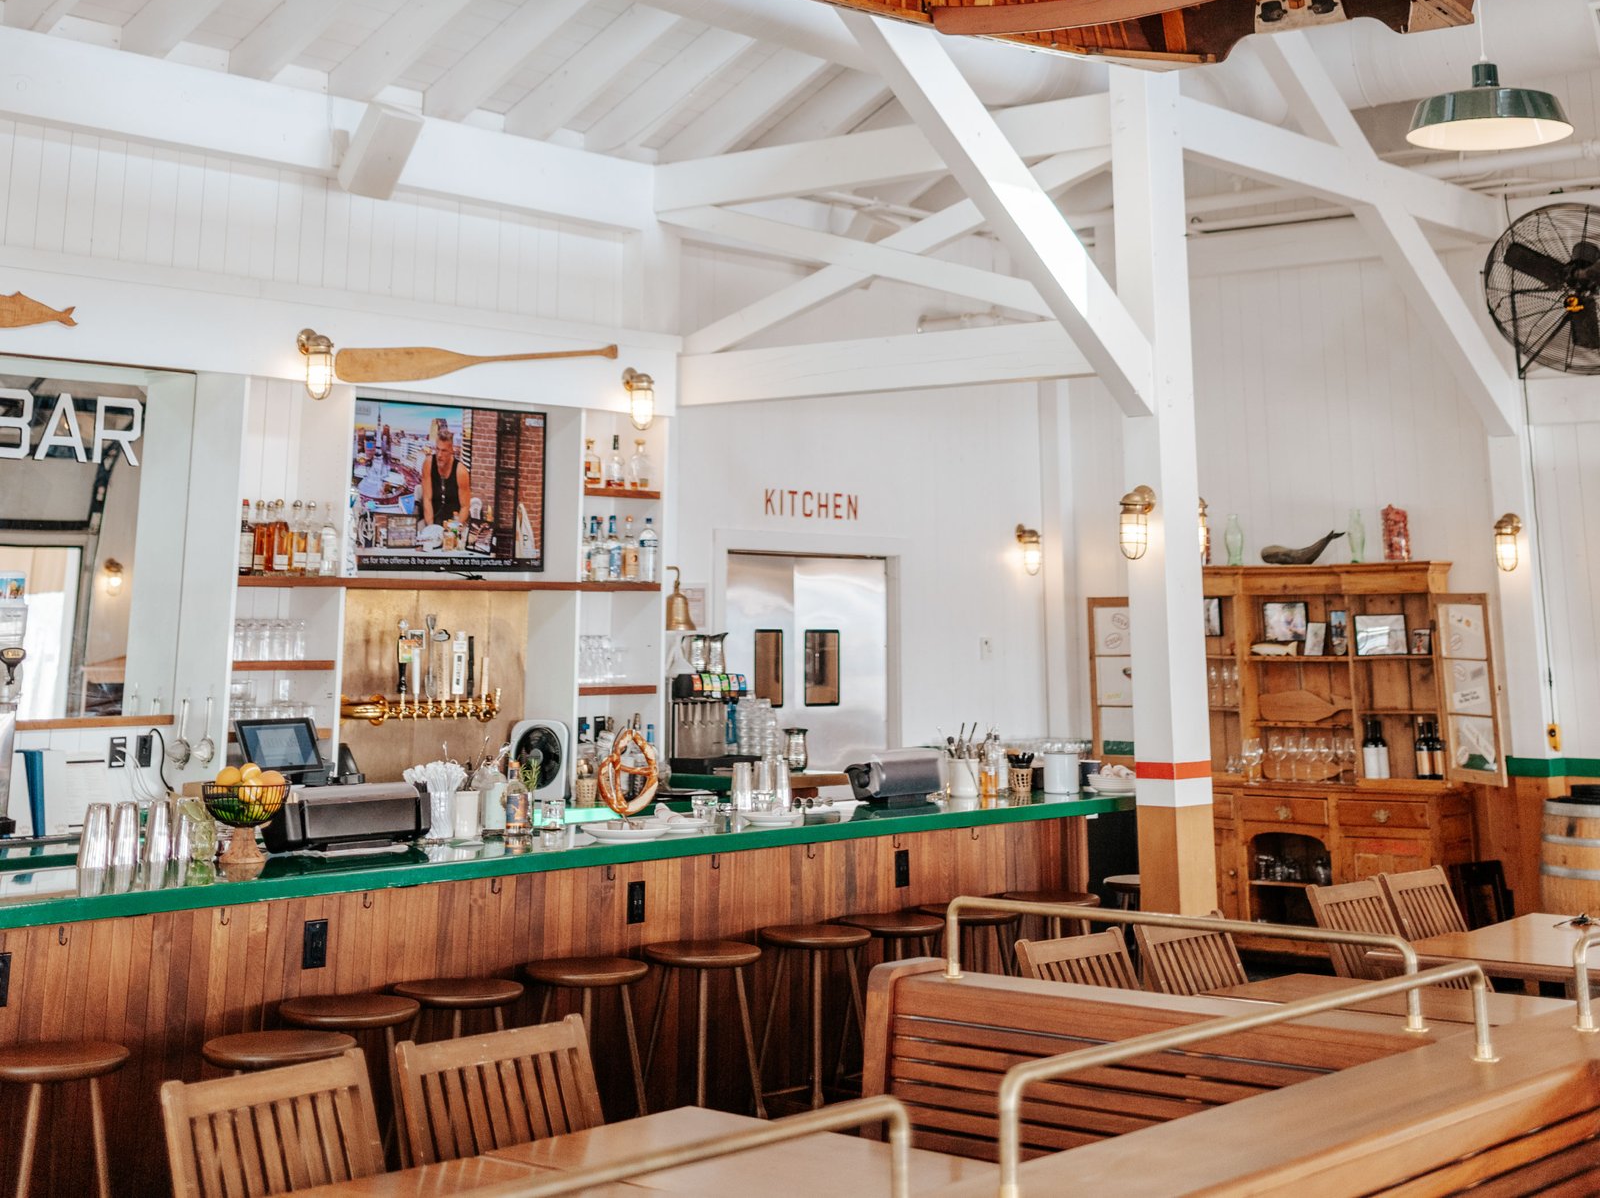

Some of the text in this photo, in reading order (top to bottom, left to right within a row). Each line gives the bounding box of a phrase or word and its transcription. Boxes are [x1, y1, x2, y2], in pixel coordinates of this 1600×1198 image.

[0, 388, 143, 467] BAR
[765, 489, 858, 521] KITCHEN
[370, 556, 379, 565] for
[379, 556, 389, 565] the
[389, 556, 410, 565] offense
[417, 556, 425, 565] he
[425, 557, 451, 566] answered
[470, 558, 480, 566] this
